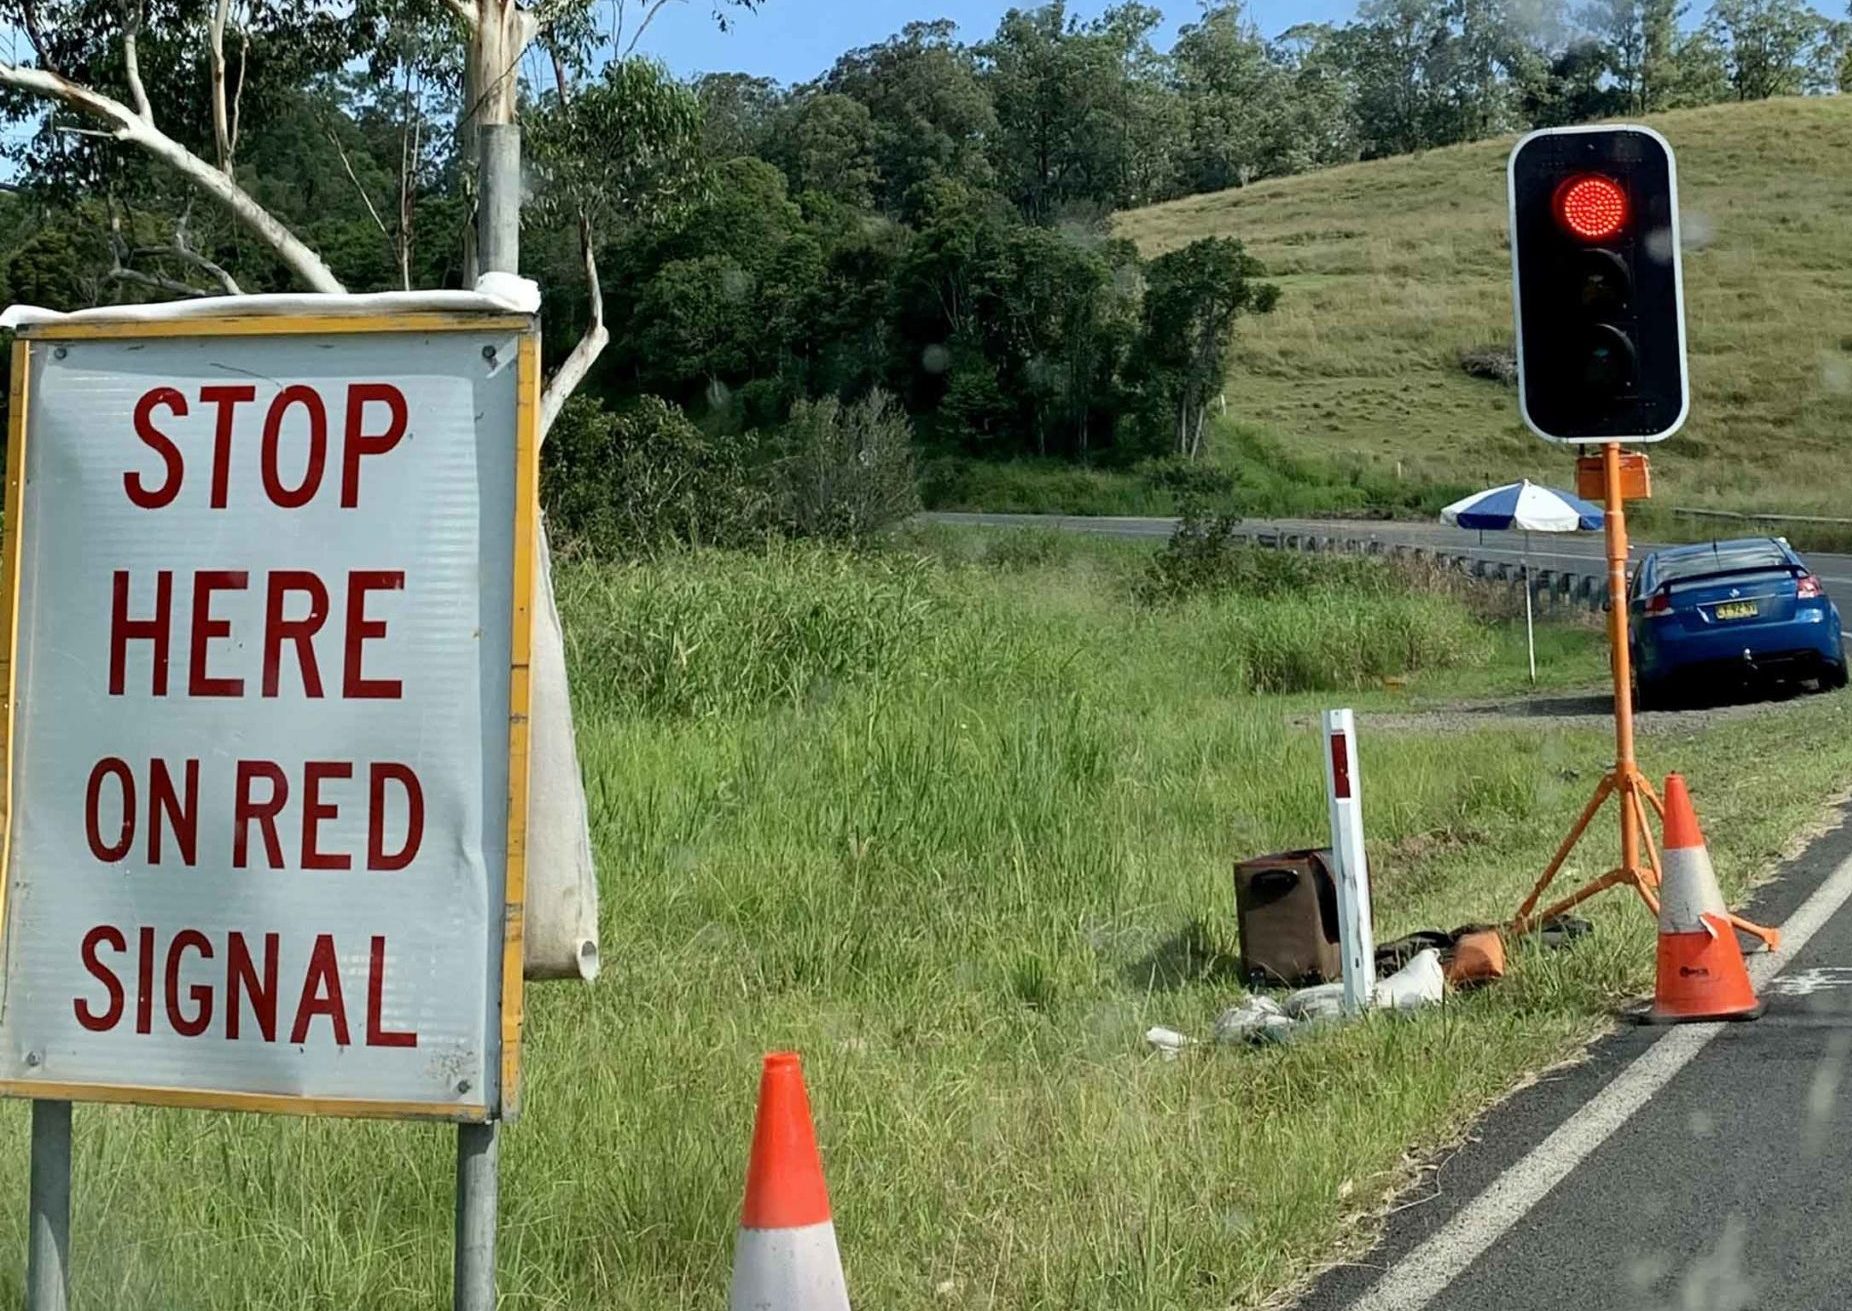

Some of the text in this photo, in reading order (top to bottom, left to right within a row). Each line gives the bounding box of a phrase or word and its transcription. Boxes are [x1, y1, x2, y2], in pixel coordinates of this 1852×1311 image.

[123, 383, 408, 508] STOP
[109, 571, 406, 699] HERE
[85, 758, 425, 871] ON RED
[74, 925, 418, 1048] SIGNAL
